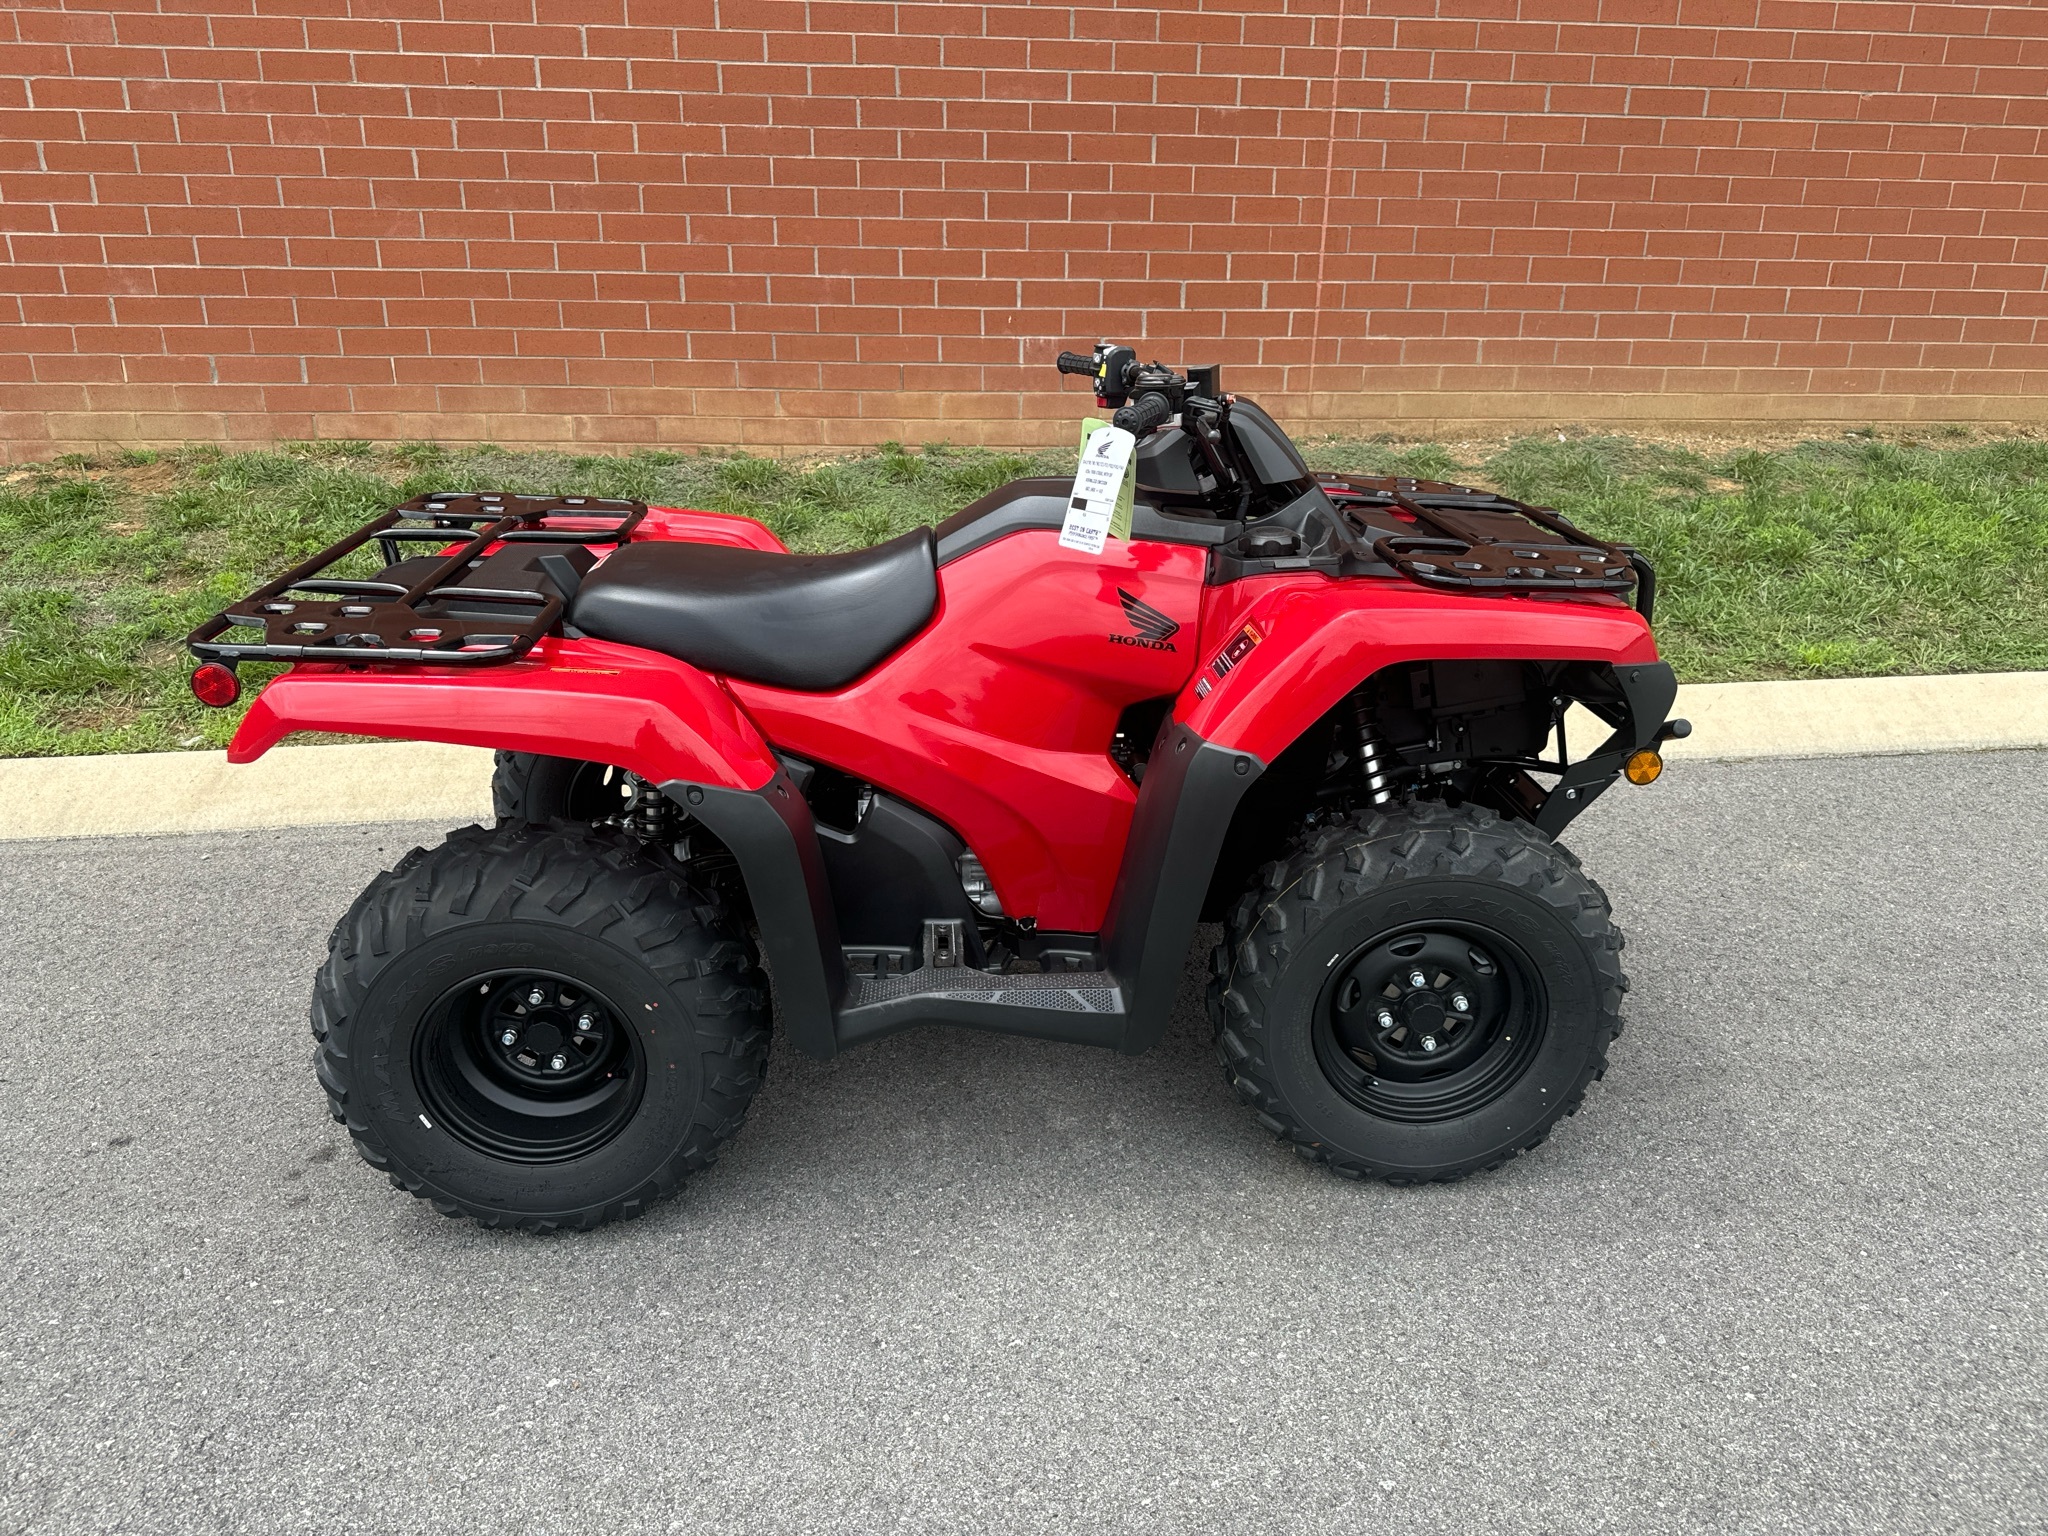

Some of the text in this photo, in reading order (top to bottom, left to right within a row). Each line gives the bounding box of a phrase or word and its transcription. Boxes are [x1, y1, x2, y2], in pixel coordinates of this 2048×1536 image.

[1108, 633, 1178, 653] HONDA
[1343, 895, 1542, 946] MAXXIS
[371, 953, 457, 1123] MAXXIS
